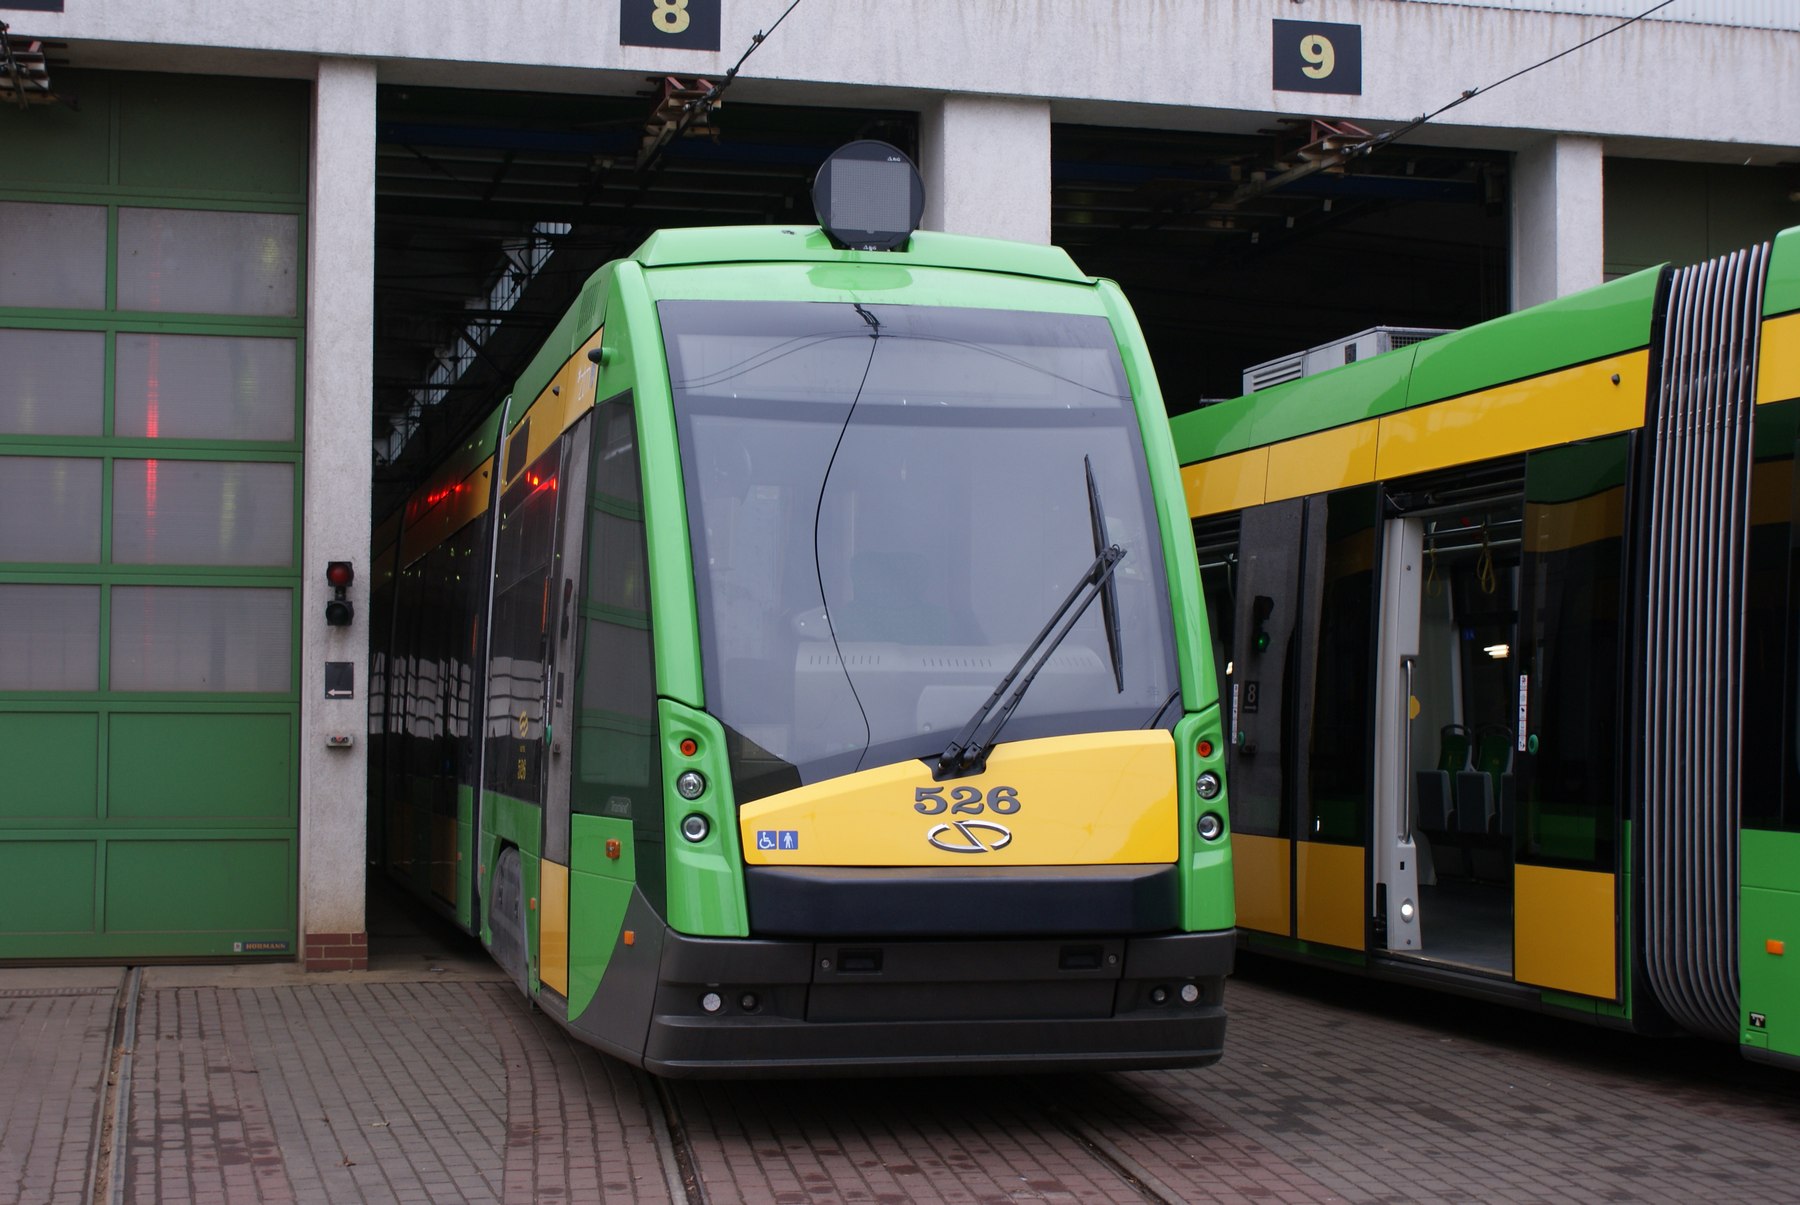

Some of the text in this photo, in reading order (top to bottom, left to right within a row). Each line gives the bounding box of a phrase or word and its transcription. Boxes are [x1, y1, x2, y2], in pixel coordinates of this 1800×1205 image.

[651, 0, 690, 34] 8
[1300, 34, 1335, 79] 9
[913, 785, 1021, 815] 526
